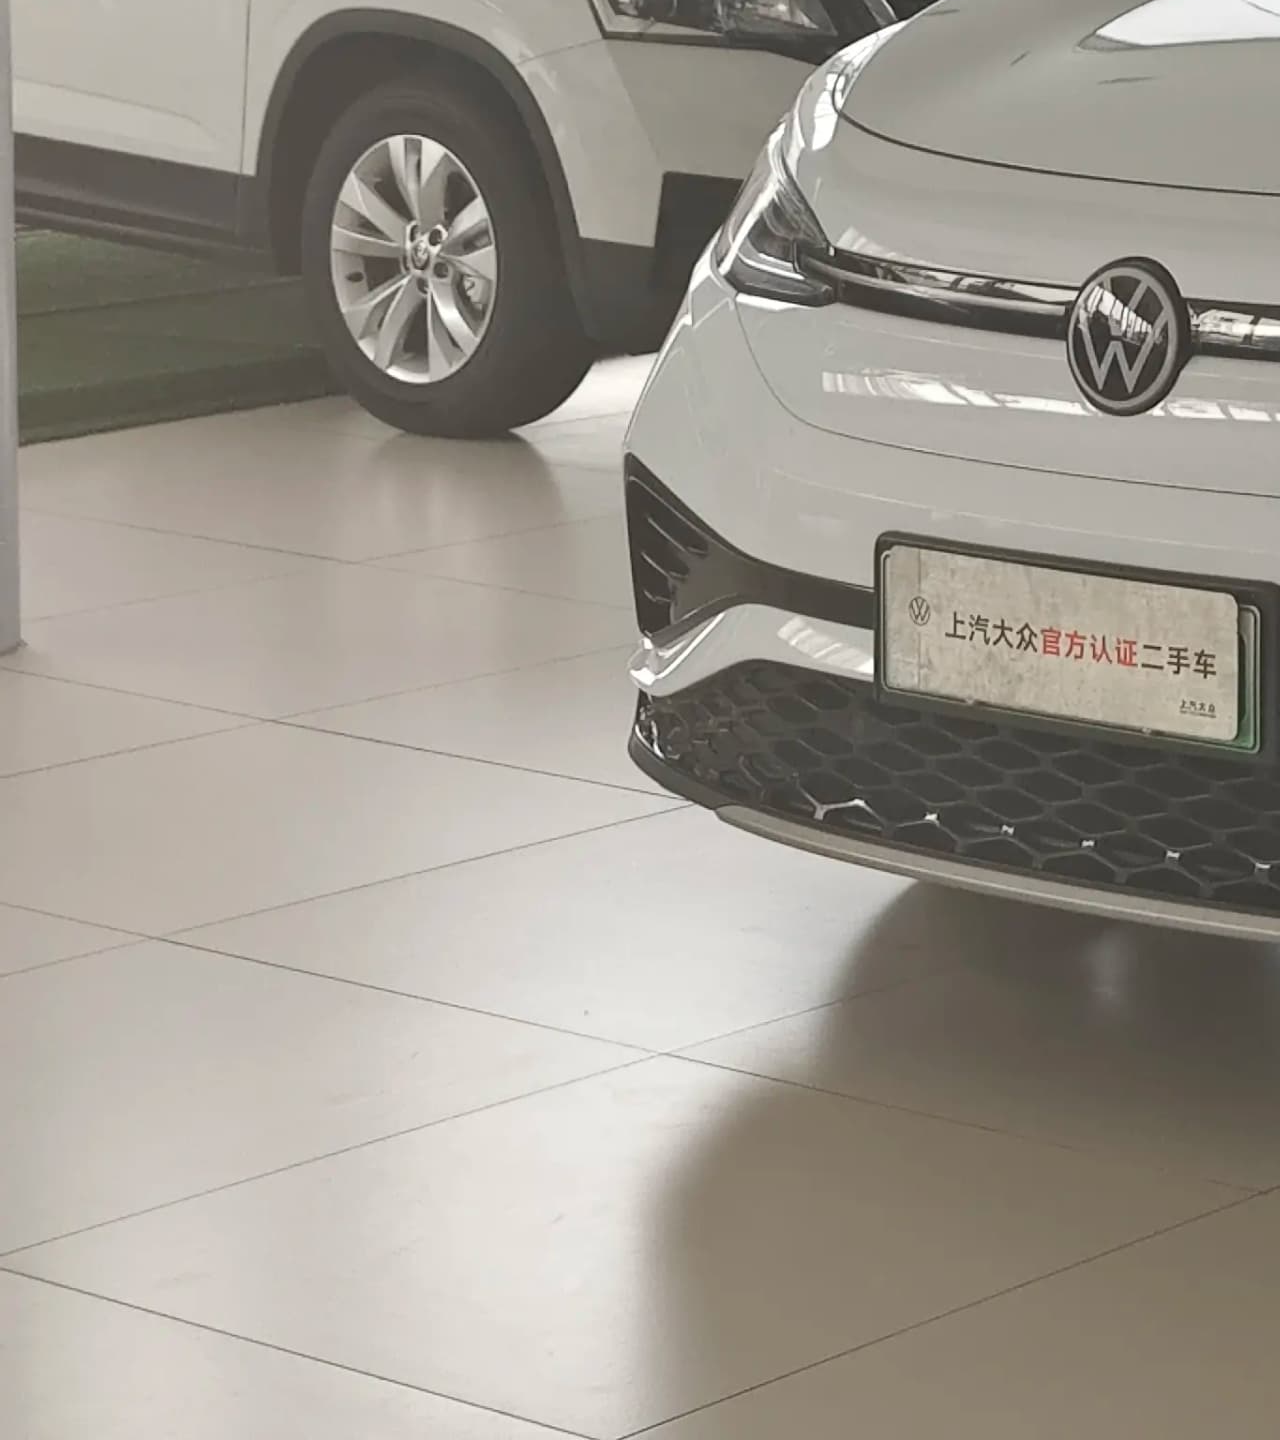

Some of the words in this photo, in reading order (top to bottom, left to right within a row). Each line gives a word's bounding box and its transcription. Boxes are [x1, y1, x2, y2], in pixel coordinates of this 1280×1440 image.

[945, 611, 1218, 680] 上汽大众官方认证二手车
